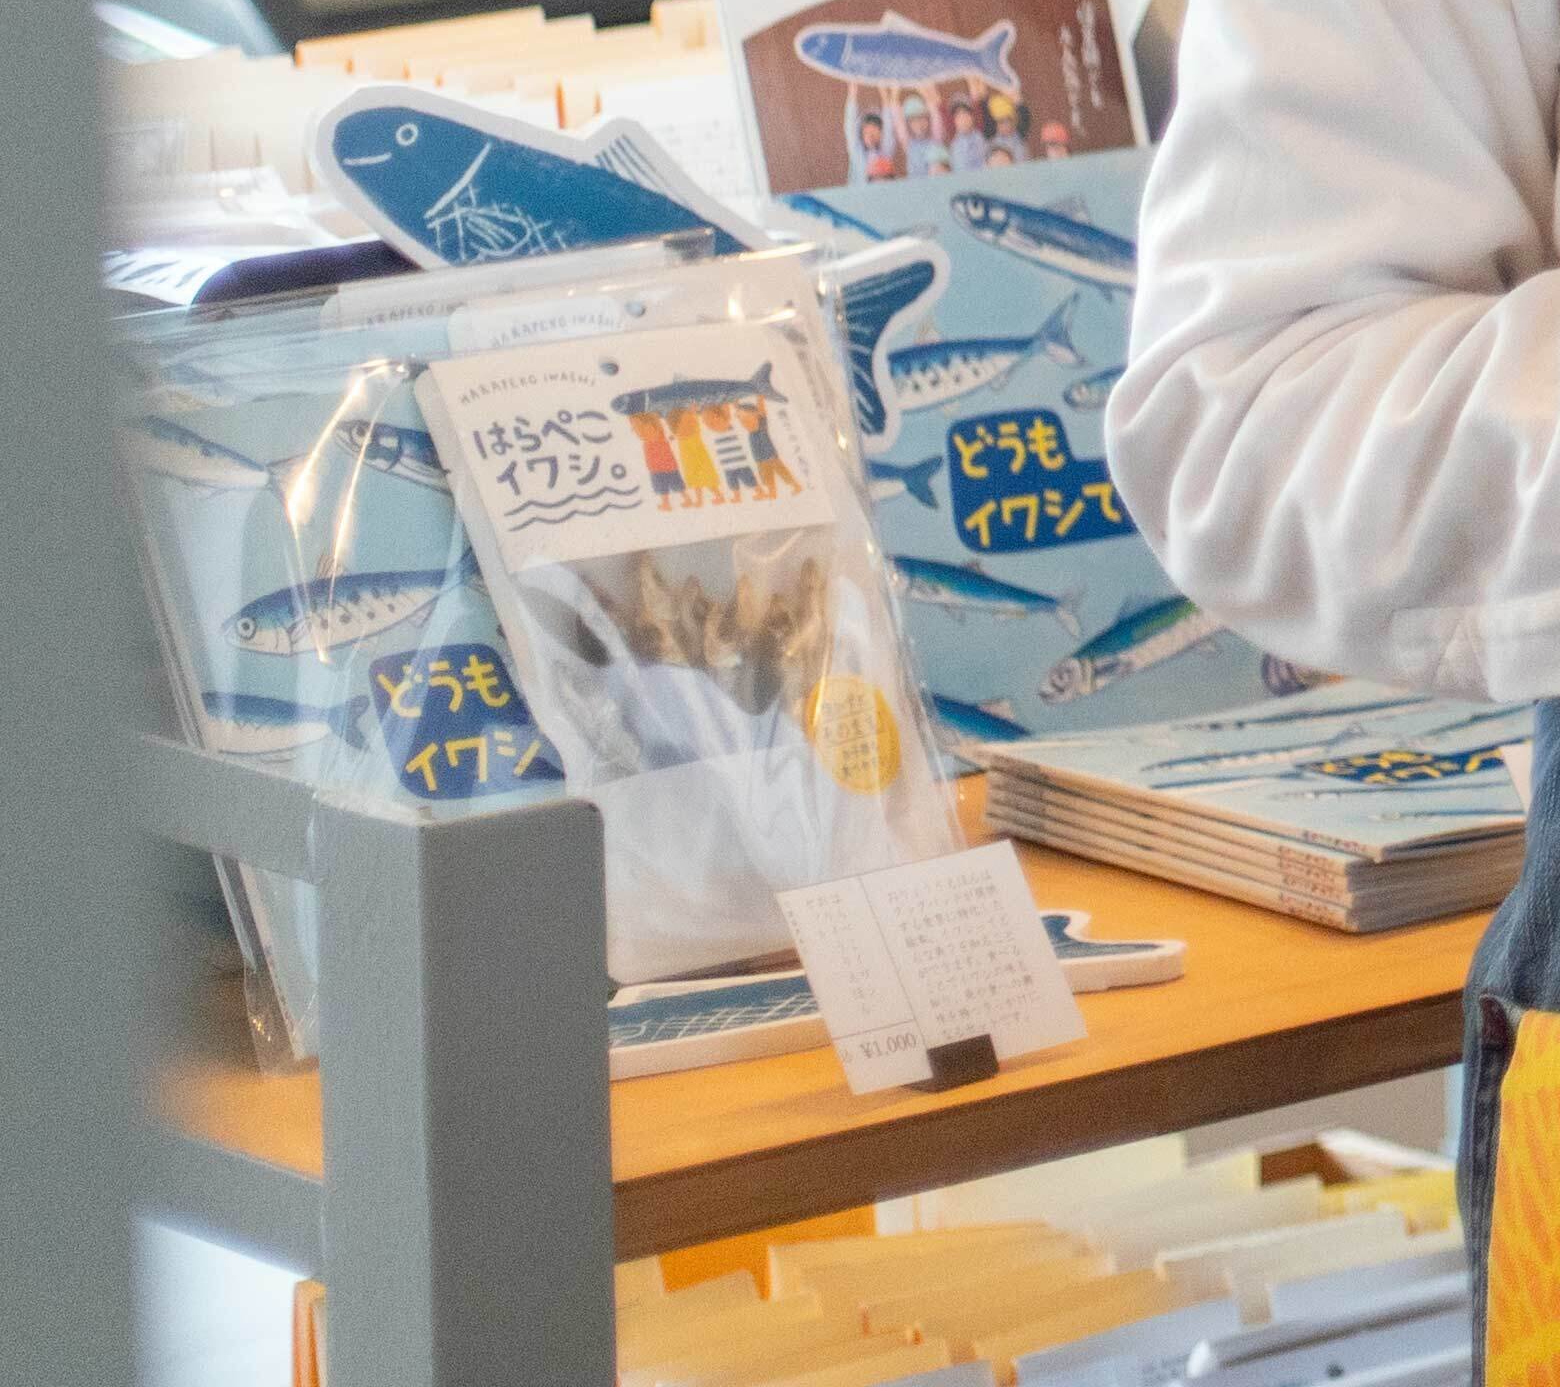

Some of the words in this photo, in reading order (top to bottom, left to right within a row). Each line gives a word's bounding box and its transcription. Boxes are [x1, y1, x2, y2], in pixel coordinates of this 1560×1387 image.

[473, 409, 614, 460] はらぺこ
[952, 418, 1066, 478] どうも
[496, 454, 628, 496] イワシ。
[377, 654, 511, 718] どうも
[858, 1030, 919, 1060] ¥1,000
